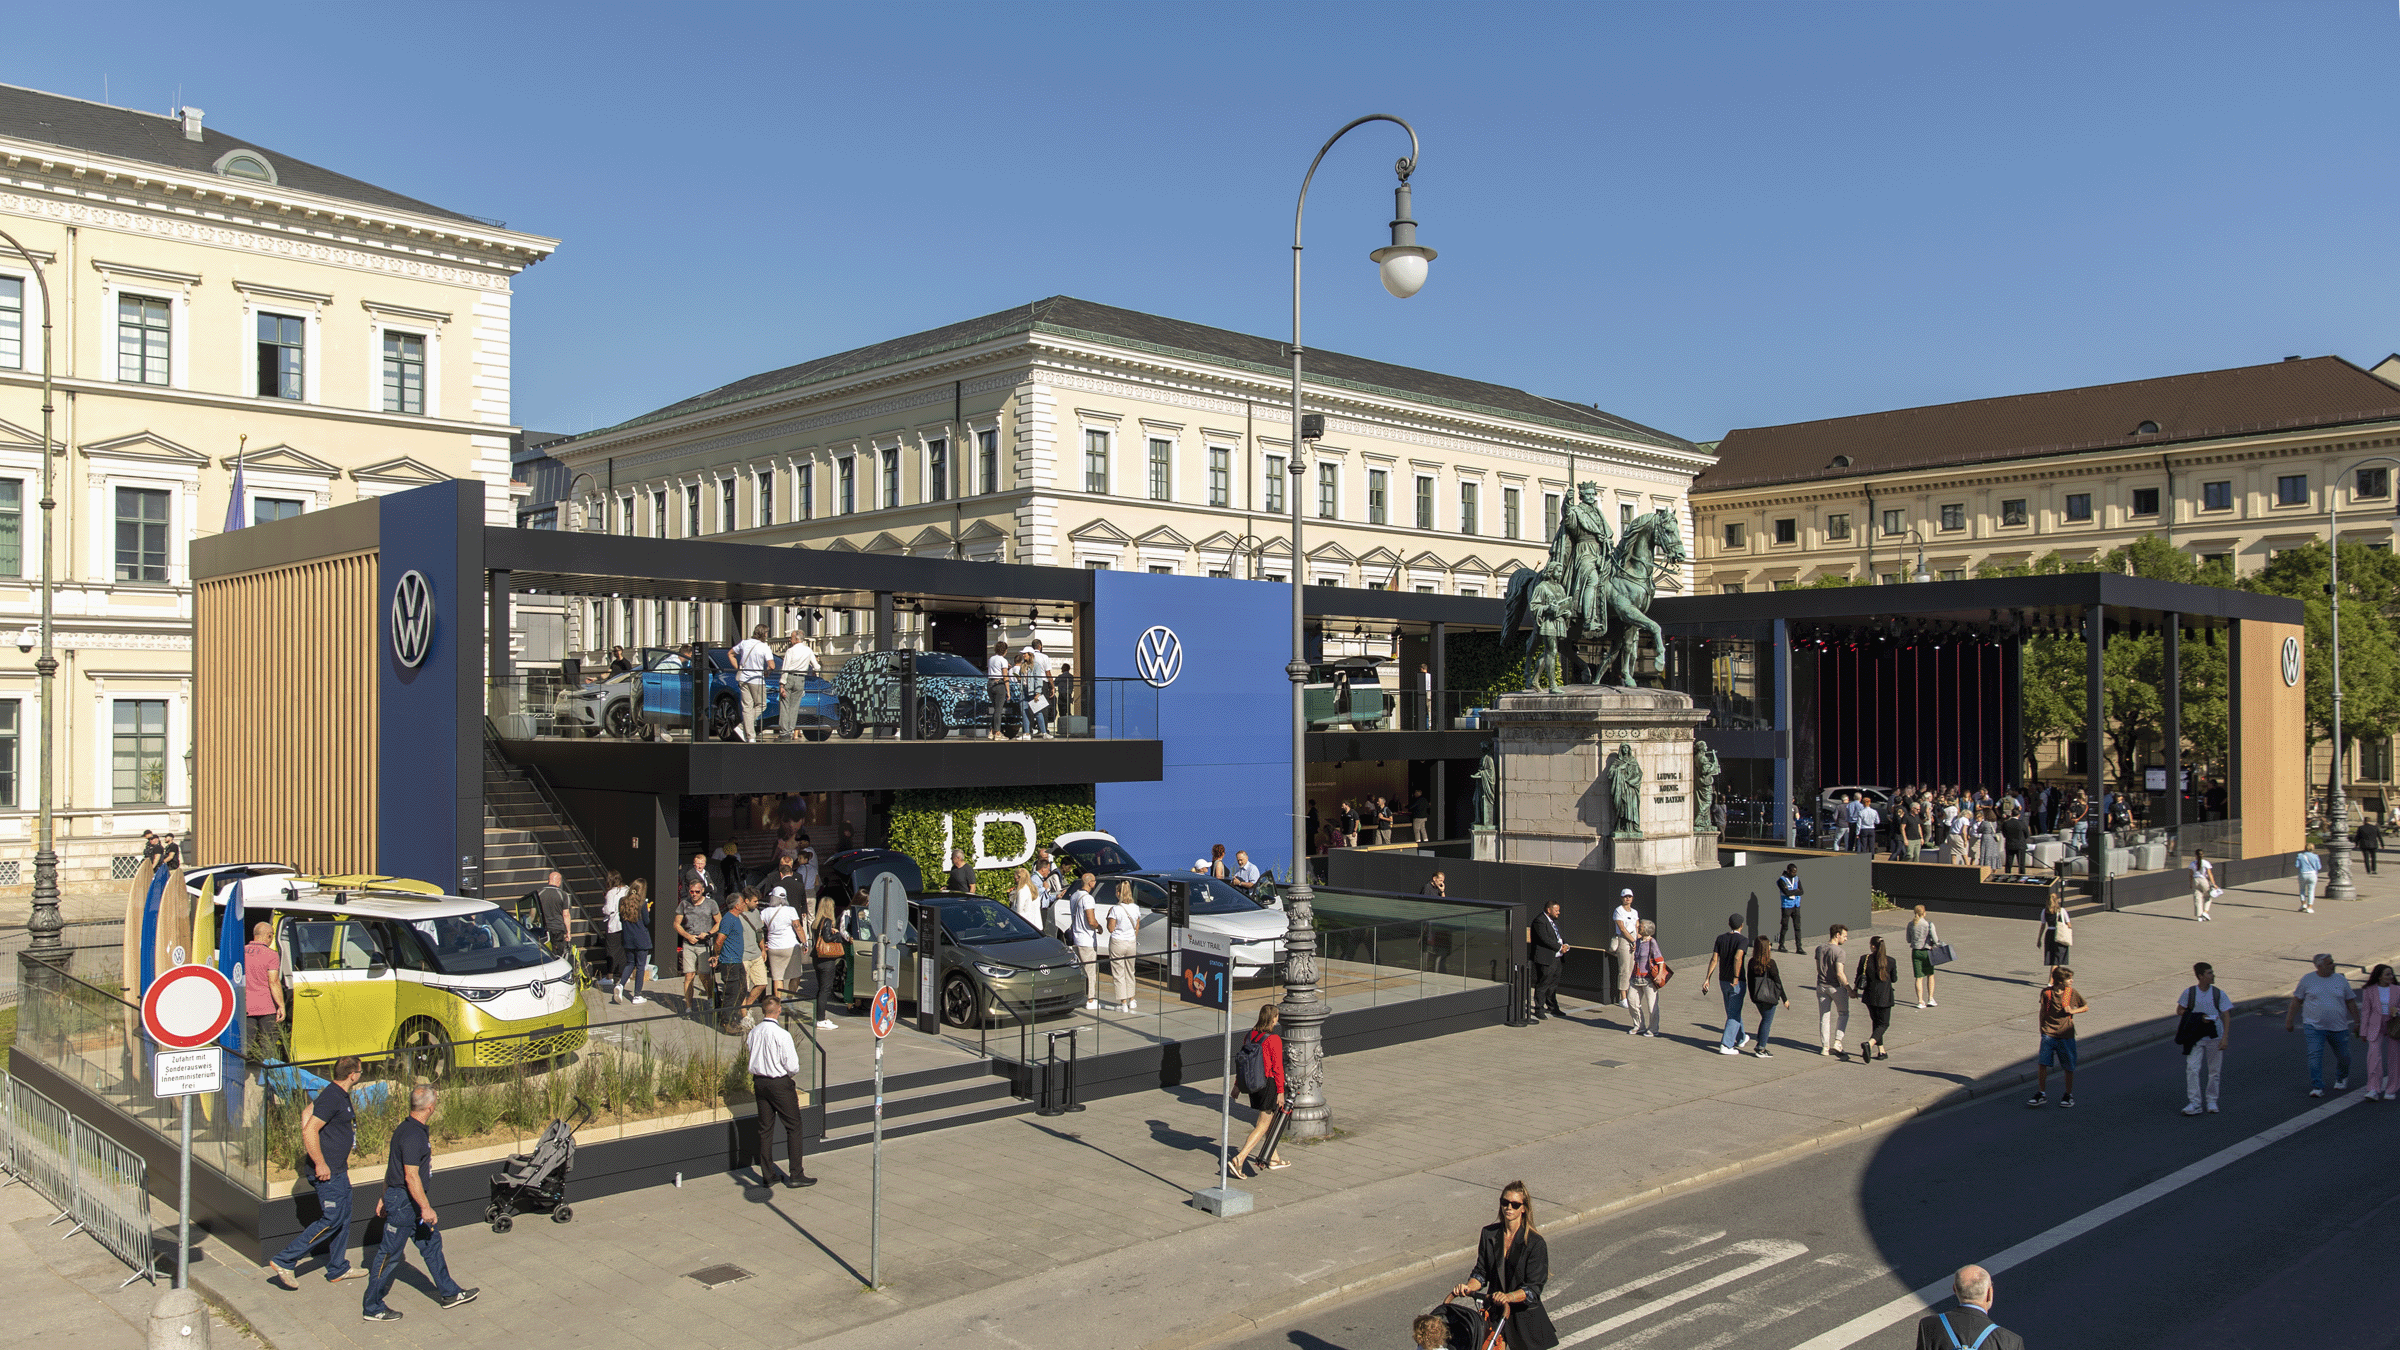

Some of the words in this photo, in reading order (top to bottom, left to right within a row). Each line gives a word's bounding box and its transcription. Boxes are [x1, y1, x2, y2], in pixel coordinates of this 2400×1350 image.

[391, 569, 431, 668] VW
[1135, 625, 1183, 687] VW
[1657, 772, 1677, 780] LUDWIG
[1659, 784, 1679, 792] KOENIG
[1653, 796, 1664, 804] VON
[1665, 795, 1685, 803] BAYERN
[942, 810, 1037, 872] ID
[1189, 938, 1206, 948] FAMILY
[1207, 941, 1221, 950] TRAIL
[1214, 972, 1223, 1003] 1
[172, 1055, 194, 1063] Zufahrt
[165, 1062, 212, 1073] Sonderausweis
[161, 1071, 216, 1082] Innenministerium
